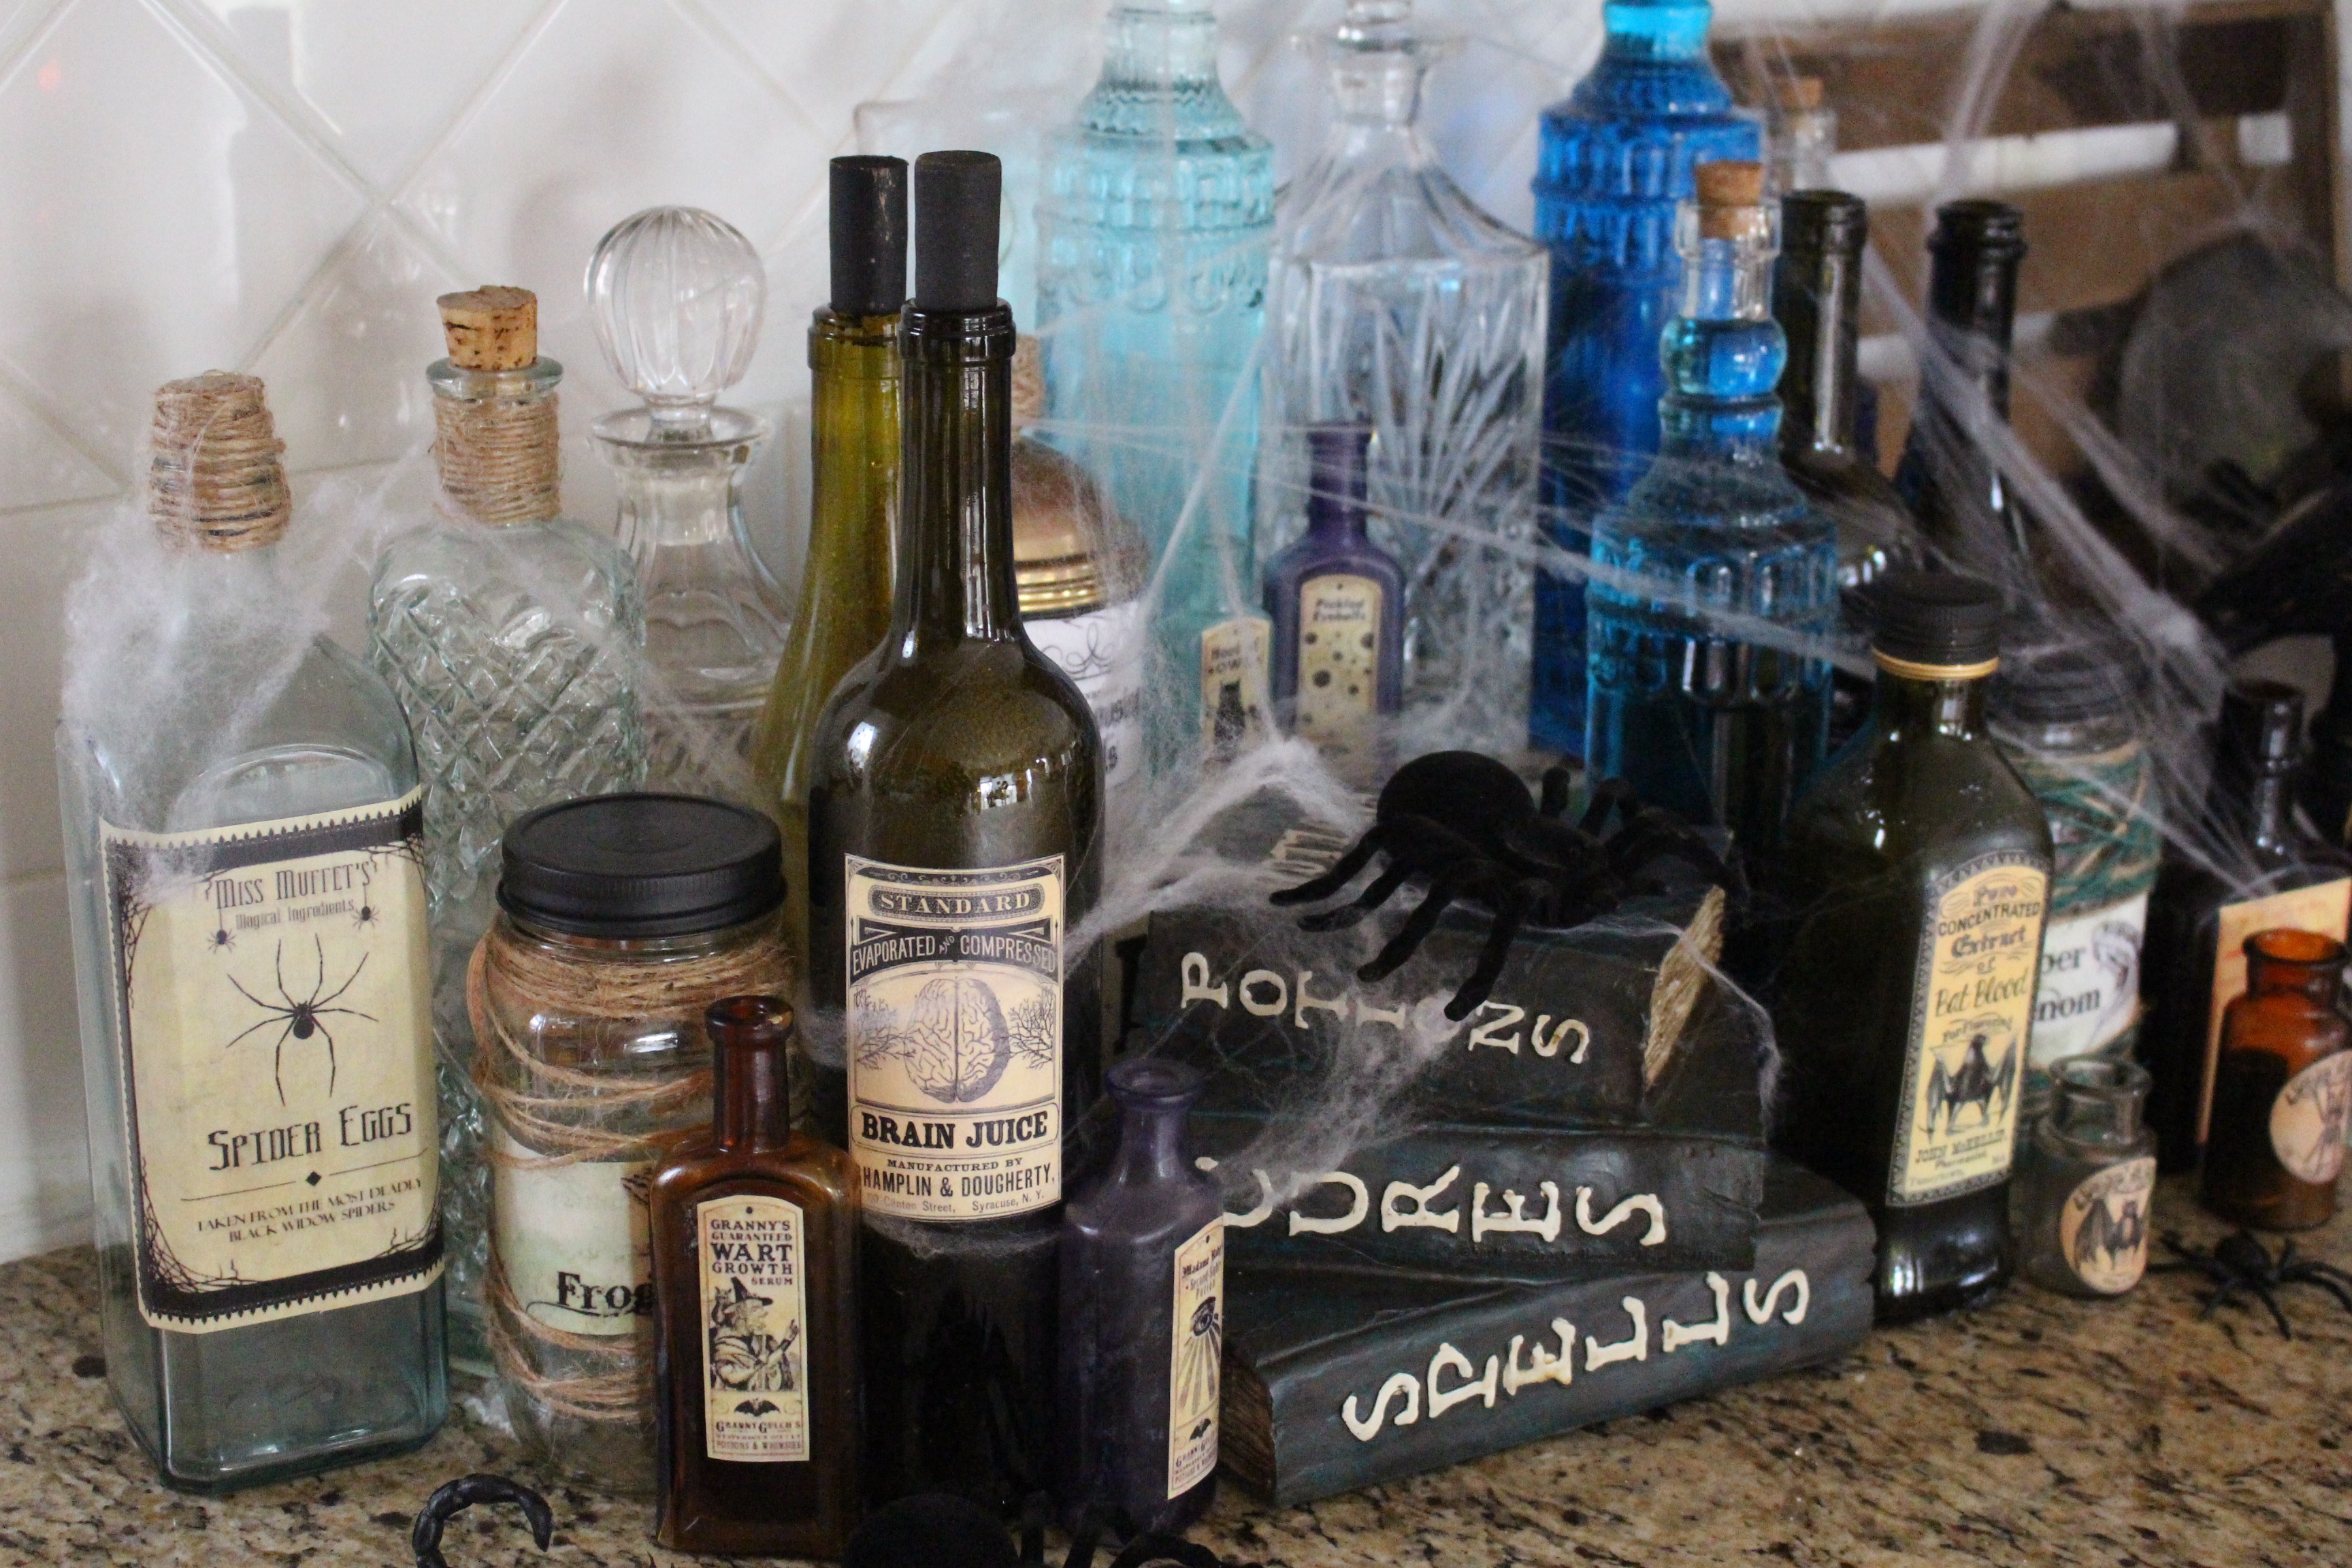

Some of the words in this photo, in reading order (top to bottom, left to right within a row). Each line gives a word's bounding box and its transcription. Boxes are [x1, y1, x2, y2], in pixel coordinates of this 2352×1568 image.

[880, 892, 1031, 915] STANDARD
[1938, 902, 2041, 936] CONCENTRATED
[852, 935, 936, 976] EVAPORATED
[938, 935, 956, 954] AND
[960, 934, 1056, 973] COMPRESSED
[1935, 983, 1969, 1017] Bat
[1973, 968, 2029, 1009] Blood
[208, 1120, 322, 1171] SPIDER
[338, 1102, 412, 1147] EGGS
[861, 1111, 956, 1149] BRAIN
[965, 1110, 1049, 1149] JUICE
[862, 1165, 932, 1197] HAMPLIN
[939, 1177, 953, 1197] &
[961, 1162, 1056, 1198] DOUGHERTY,
[887, 1159, 999, 1173] MANUFACTURED
[1005, 1158, 1024, 1167] BY
[197, 1213, 246, 1232] TAKEN
[250, 1204, 295, 1223] FROM
[298, 1199, 323, 1214] THE
[327, 1190, 364, 1207] MOST
[229, 1224, 278, 1243] BLACK
[280, 1213, 336, 1232] WIDOW
[340, 1200, 397, 1221] SPIDERS
[710, 1218, 791, 1231] GRANNY'S
[710, 1243, 794, 1262] WART
[712, 1262, 794, 1276] GROWTH
